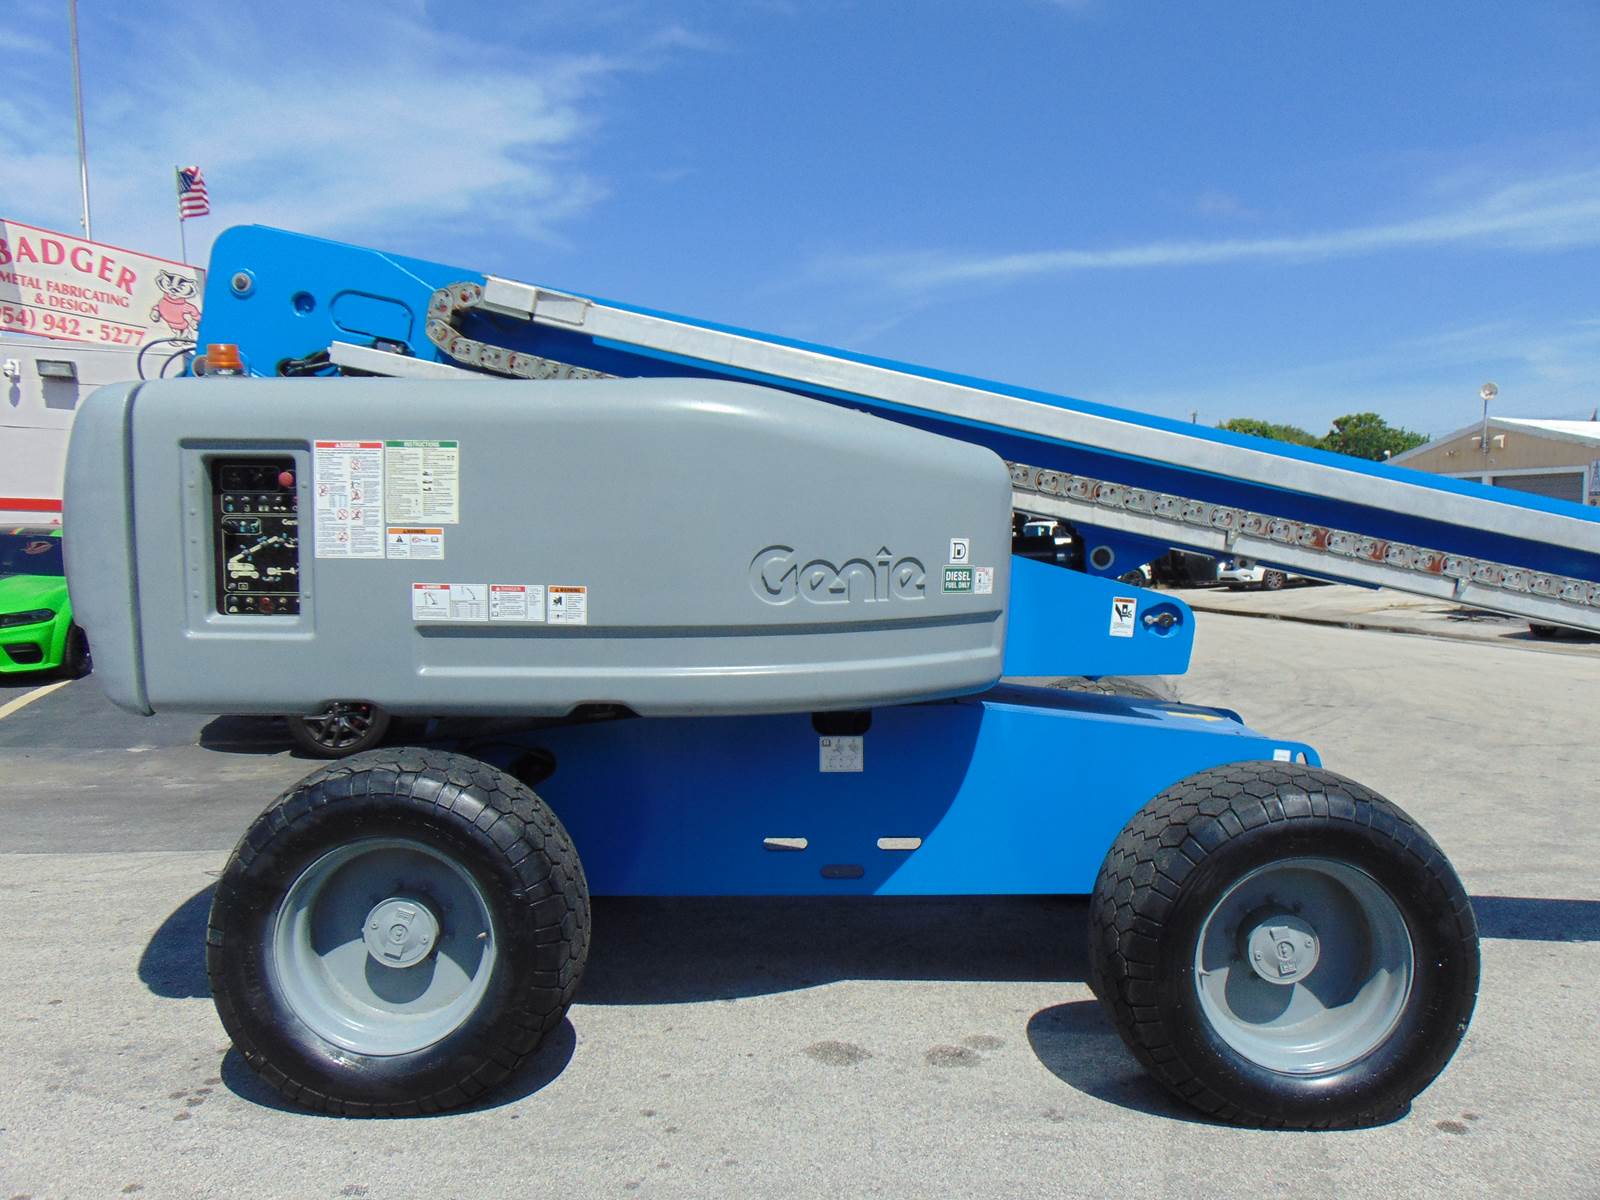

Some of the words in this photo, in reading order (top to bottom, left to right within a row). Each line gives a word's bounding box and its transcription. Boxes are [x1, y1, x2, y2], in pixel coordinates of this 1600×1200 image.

[0, 271, 42, 290] METAL
[46, 280, 130, 309] FABRICATING
[34, 292, 45, 305] &
[49, 295, 99, 316] DESIGN
[0, 305, 37, 330] 54)
[42, 314, 81, 337] 942
[99, 325, 146, 347] 5277
[749, 545, 926, 606] Genie
[945, 571, 971, 581] DIESEL
[945, 581, 958, 589] FUEL
[958, 581, 971, 589] ONLY
